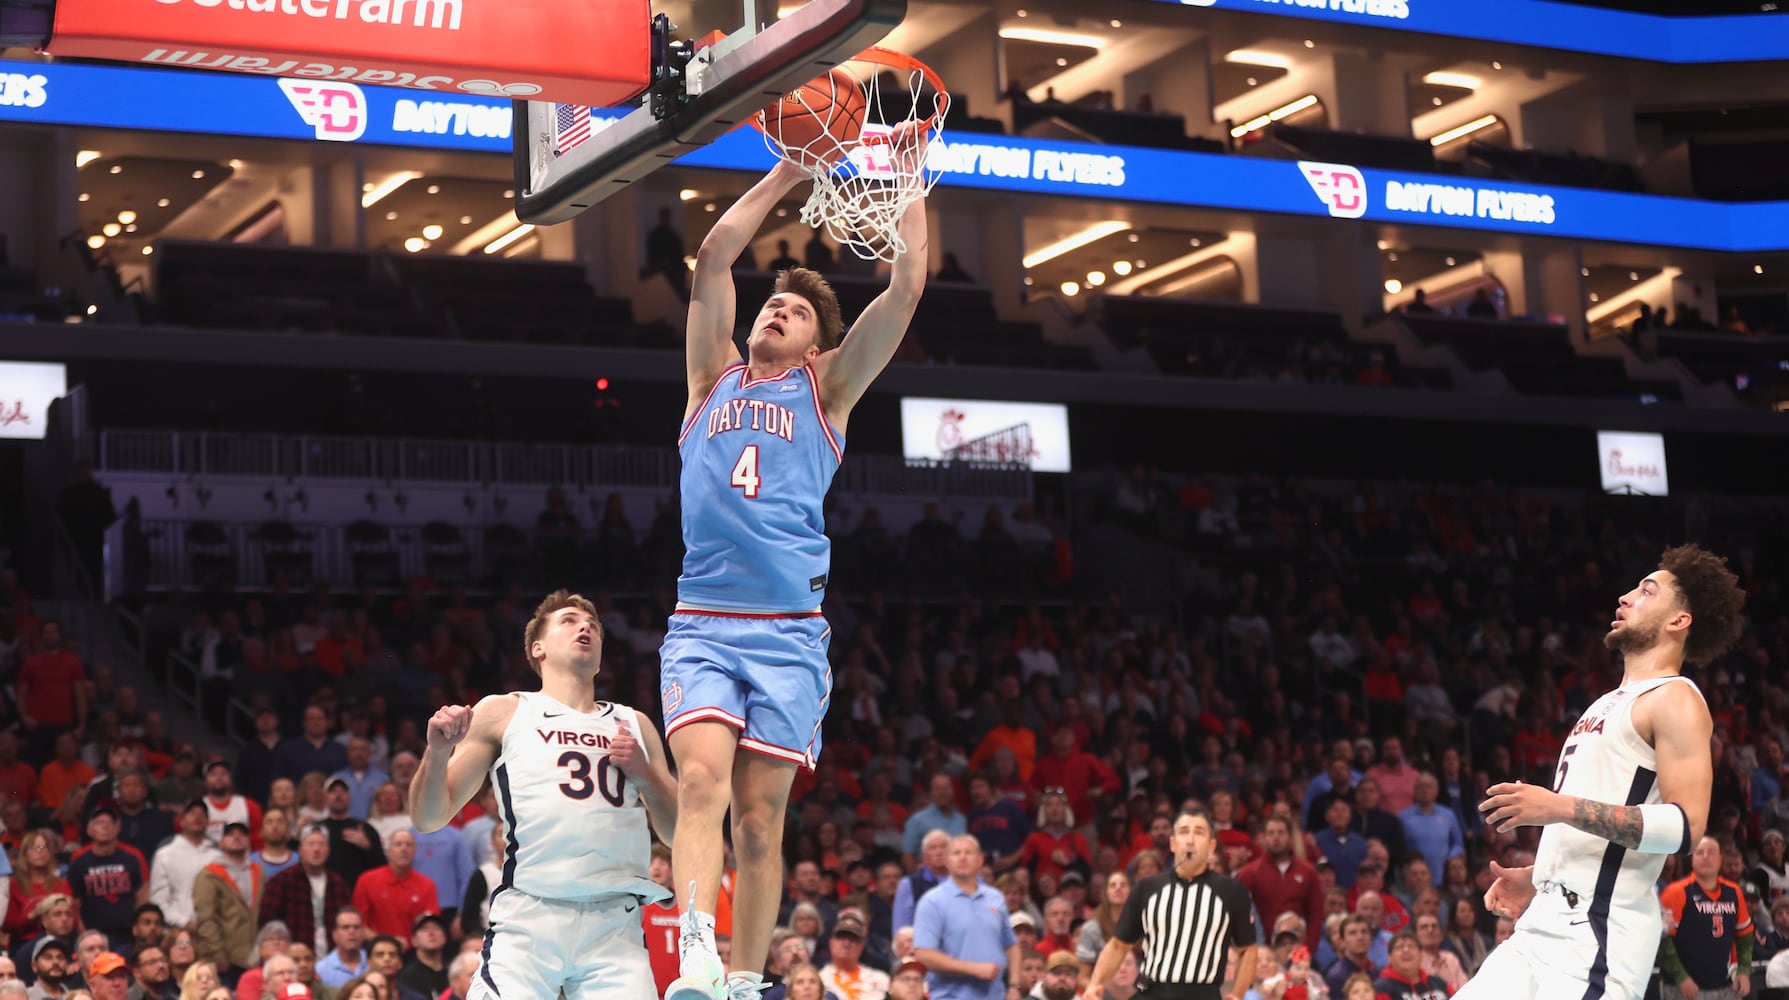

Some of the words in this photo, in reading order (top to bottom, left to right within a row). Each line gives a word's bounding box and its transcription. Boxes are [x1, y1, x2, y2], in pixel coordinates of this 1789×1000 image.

[192, 0, 463, 30] eFarm
[392, 99, 512, 139] DAYTON
[925, 141, 1030, 179] DAYTON
[1033, 149, 1126, 187] FLYERS
[1385, 180, 1475, 217] DAYTON
[1476, 189, 1556, 224] FLYERS
[706, 398, 796, 443] DAYTON
[731, 444, 761, 498] 4
[557, 750, 626, 808] 30
[1552, 744, 1578, 794] 5
[1695, 902, 1737, 914] VIRGINIA
[1712, 915, 1724, 938] 5
[664, 928, 676, 955] 1
